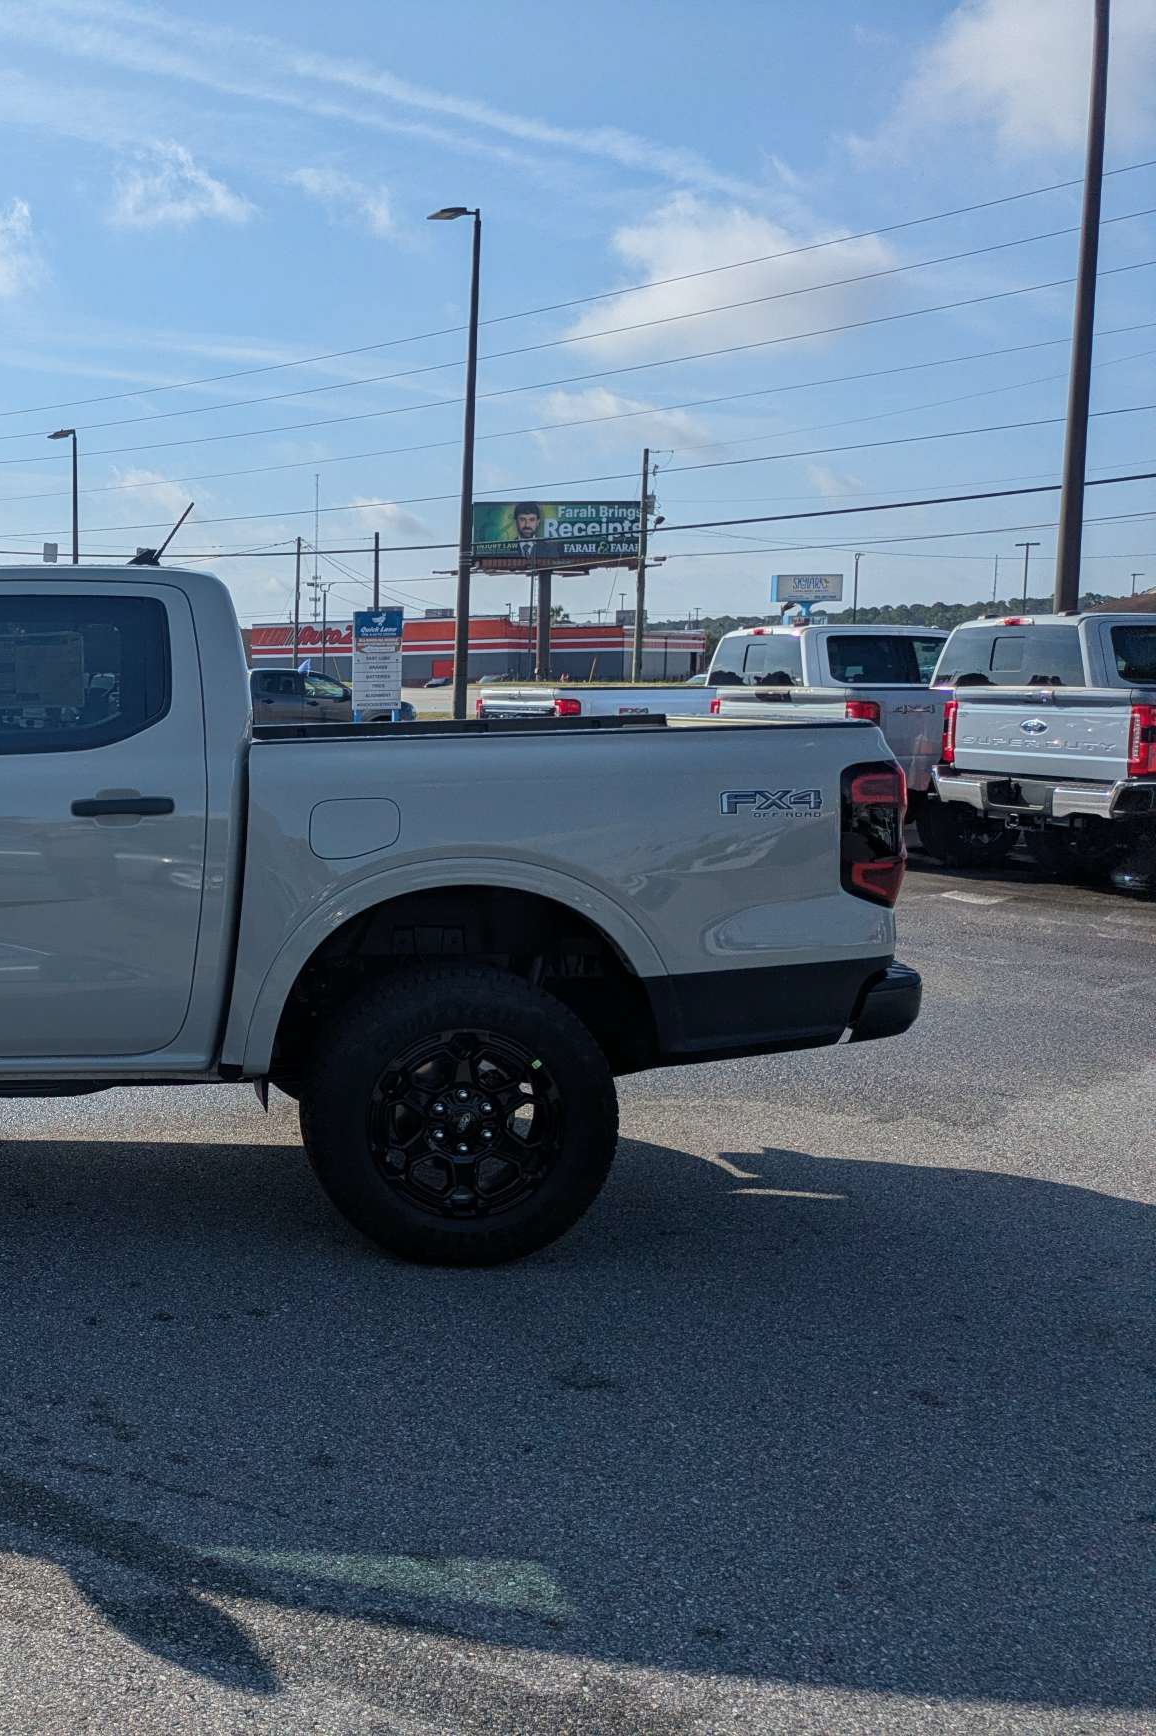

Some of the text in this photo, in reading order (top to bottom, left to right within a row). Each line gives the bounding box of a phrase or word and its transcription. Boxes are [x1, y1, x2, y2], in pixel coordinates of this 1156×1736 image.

[558, 505, 641, 521] Farah Brings
[563, 543, 595, 553] FARAH
[360, 626, 380, 634] Quick
[962, 735, 1117, 752] SUPER DUTY
[719, 789, 823, 815] FX4
